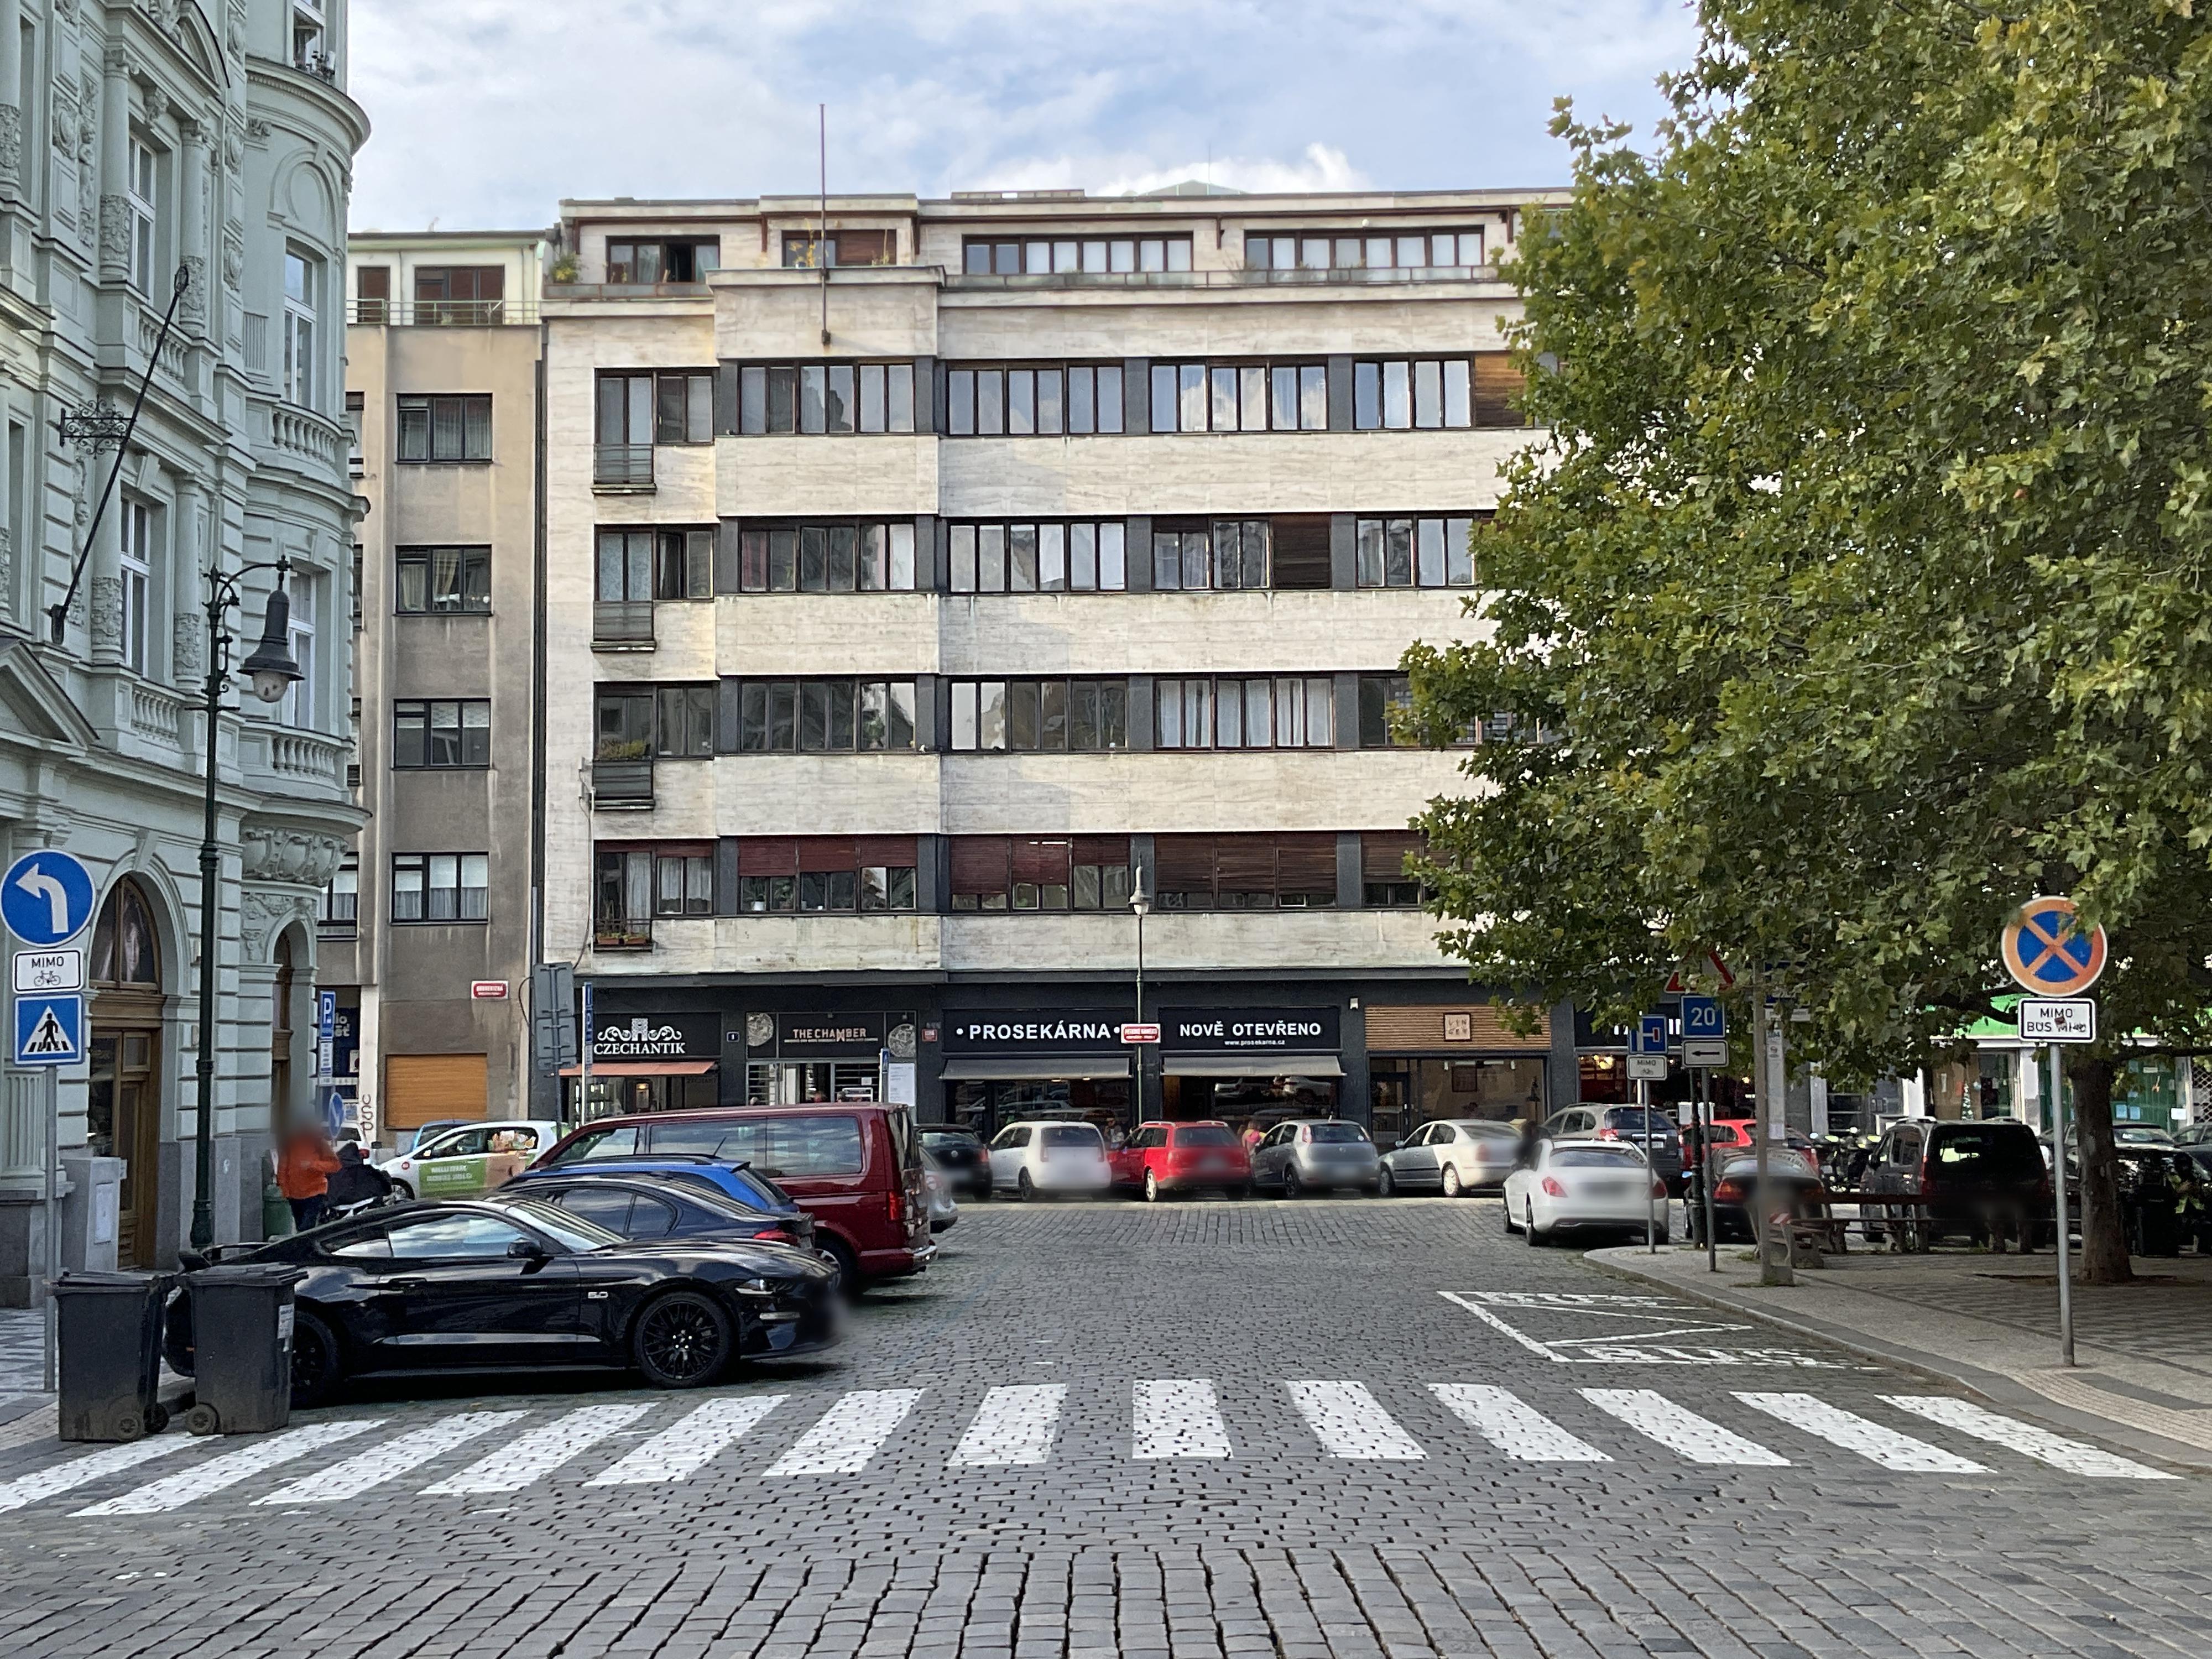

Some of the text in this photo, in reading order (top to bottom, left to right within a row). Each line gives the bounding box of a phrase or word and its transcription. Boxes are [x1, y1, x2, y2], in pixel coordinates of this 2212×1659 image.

[31, 956, 64, 968] MIMO
[323, 998, 332, 1024] P
[1691, 1007, 1715, 1026] 20
[2040, 1008, 2073, 1018] MIMO
[969, 1020, 1111, 1040] PROSEKÁRNA
[1180, 1020, 1321, 1037] NOVĚ OTEVŘENO
[2027, 1021, 2052, 1032] BUS
[793, 1029, 813, 1039] THE
[814, 1028, 867, 1042] CHAMBER
[593, 1042, 686, 1055] CZECHANTIK
[1580, 1347, 1819, 1366] BUS
